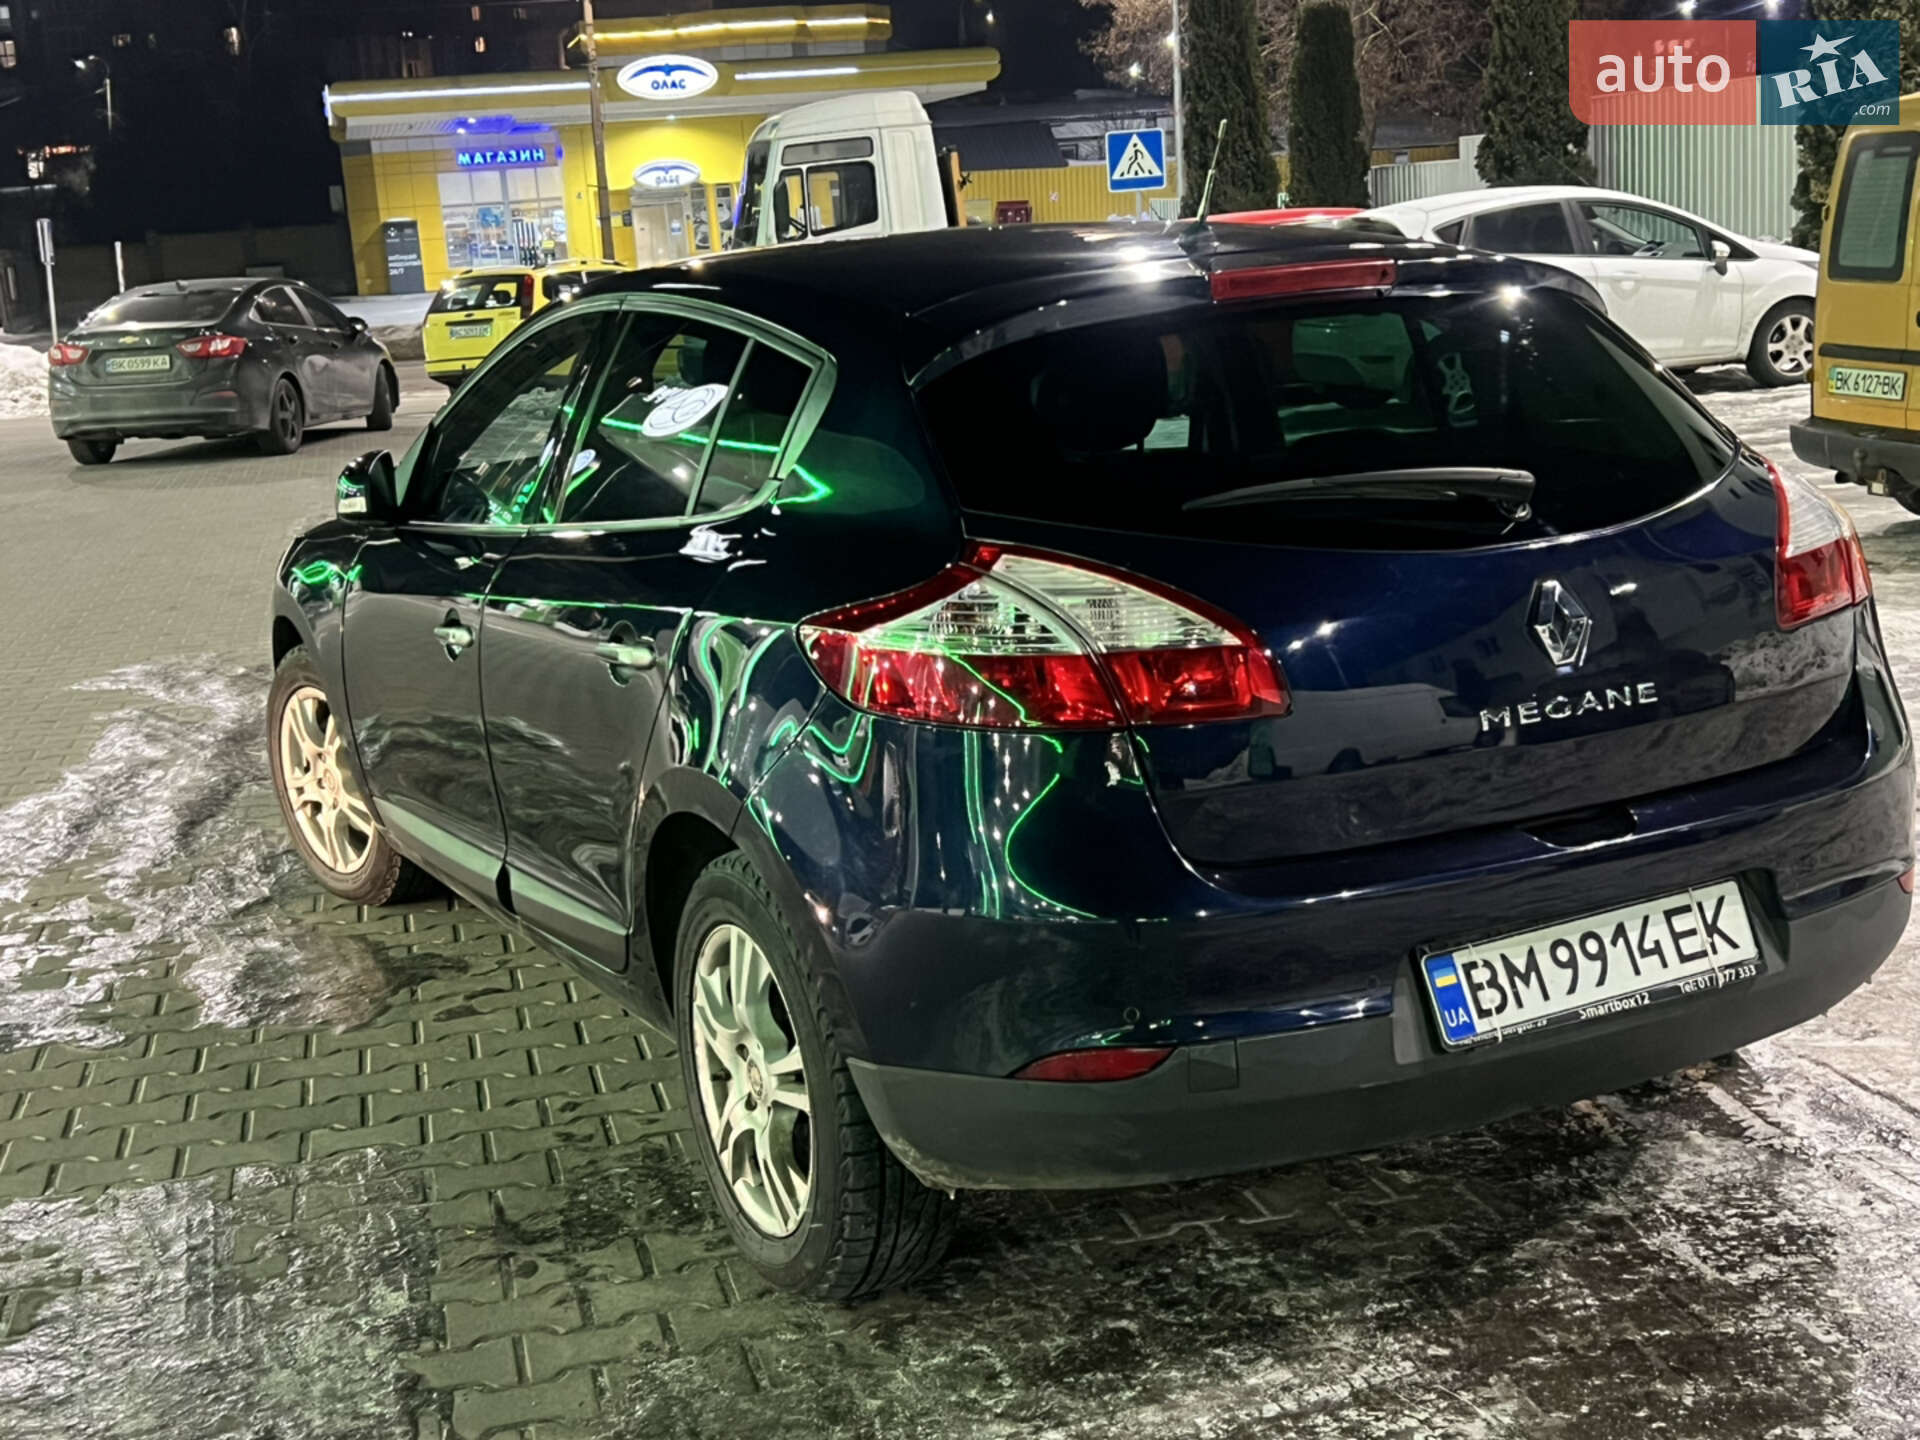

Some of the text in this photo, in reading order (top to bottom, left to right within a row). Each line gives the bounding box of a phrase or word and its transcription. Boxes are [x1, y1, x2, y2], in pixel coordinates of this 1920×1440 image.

[651, 79, 687, 91] ОЛАС
[457, 148, 545, 167] МАГАЗИН
[1579, 991, 1651, 1020] Smartbox12
[1445, 1008, 1470, 1028] UA
